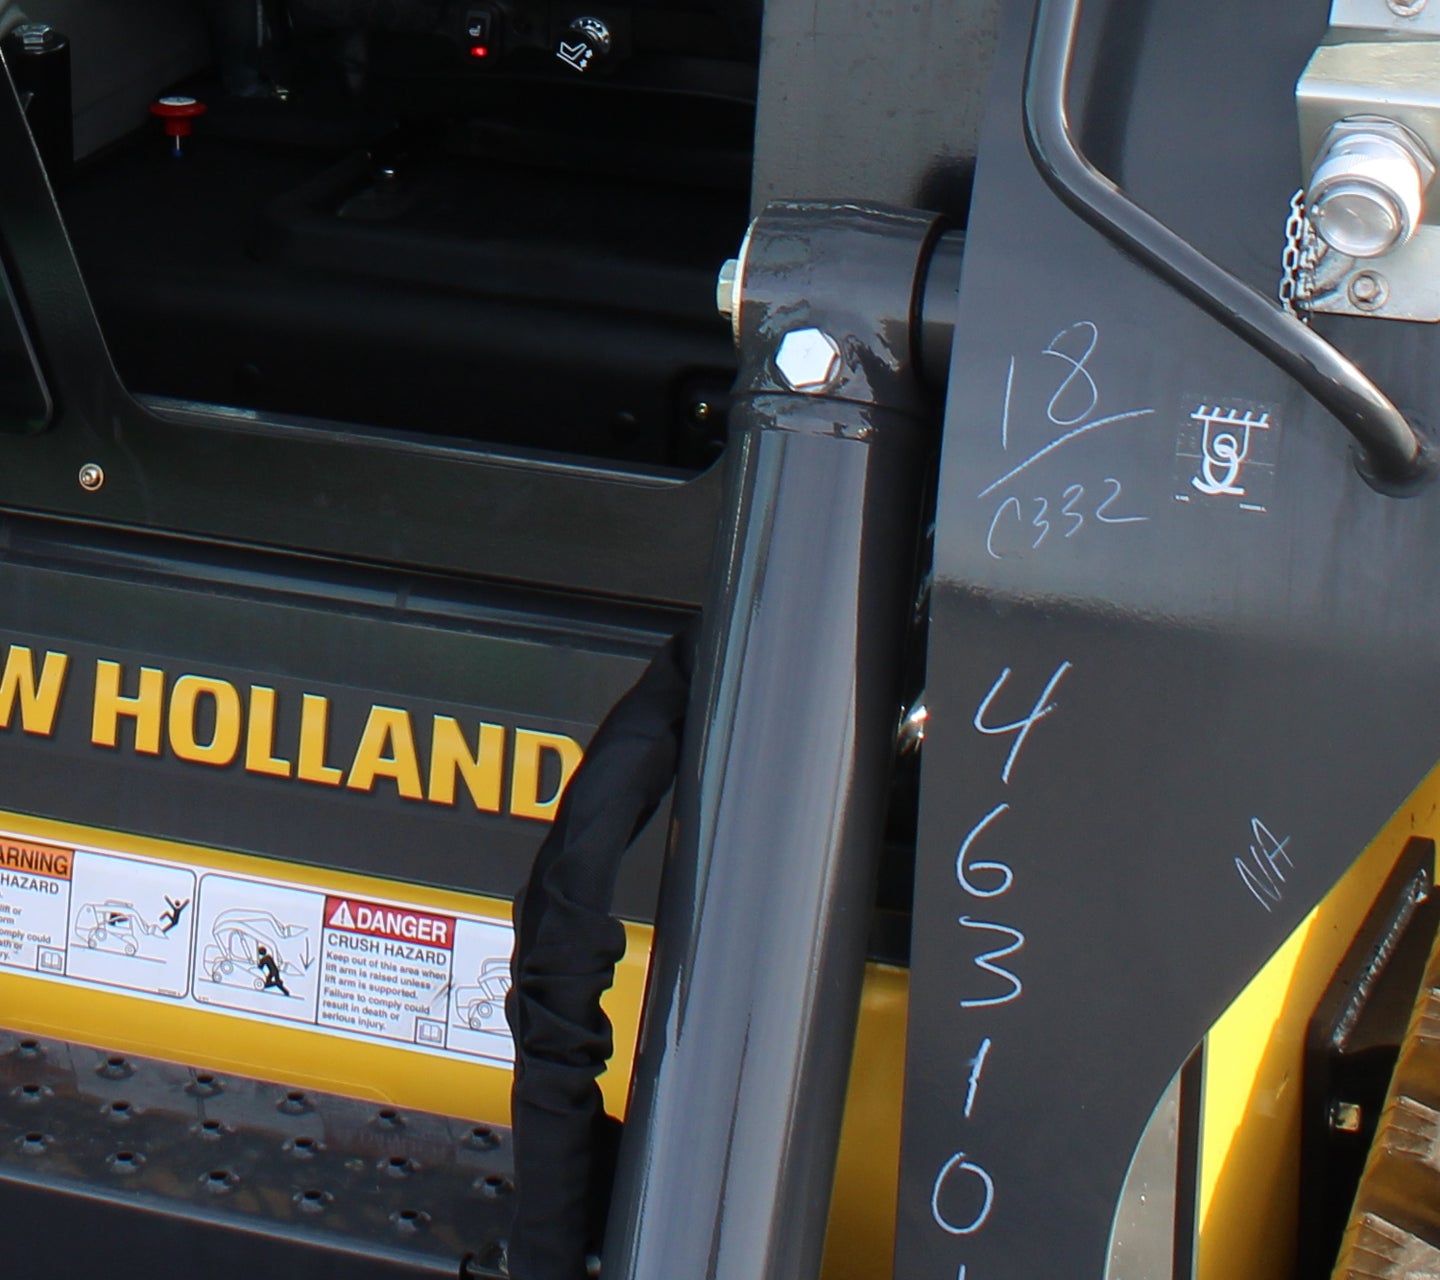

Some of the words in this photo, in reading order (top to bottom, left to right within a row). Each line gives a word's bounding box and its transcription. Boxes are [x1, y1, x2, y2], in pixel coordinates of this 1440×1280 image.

[91, 658, 586, 822] HOLLAND
[0, 872, 60, 895] HAZARD
[12, 906, 22, 916] or
[26, 931, 51, 944] could
[357, 906, 447, 944] DANGER
[327, 932, 380, 955] CRUSH
[384, 942, 447, 966] HAZARD
[325, 962, 337, 973] lift
[339, 966, 357, 977] arm
[359, 968, 368, 978] is
[370, 970, 399, 984] raised
[400, 975, 431, 990] unless
[326, 950, 349, 964] Keep
[351, 956, 366, 967] out
[369, 958, 379, 968] of
[380, 960, 397, 972] this
[400, 966, 420, 976] area
[421, 968, 446, 981] when
[323, 986, 355, 1001] Failure
[357, 993, 366, 1003] to
[368, 997, 402, 1012] comply
[404, 1002, 430, 1015] could
[324, 974, 336, 984] lift
[338, 977, 356, 988] arm
[358, 979, 367, 989] is
[368, 983, 418, 1000] supported.
[322, 999, 349, 1011] result
[351, 1003, 360, 1013] in
[362, 1006, 388, 1019] death
[390, 1013, 400, 1022] or
[322, 1010, 356, 1024] serious
[358, 1016, 385, 1031] injury.
